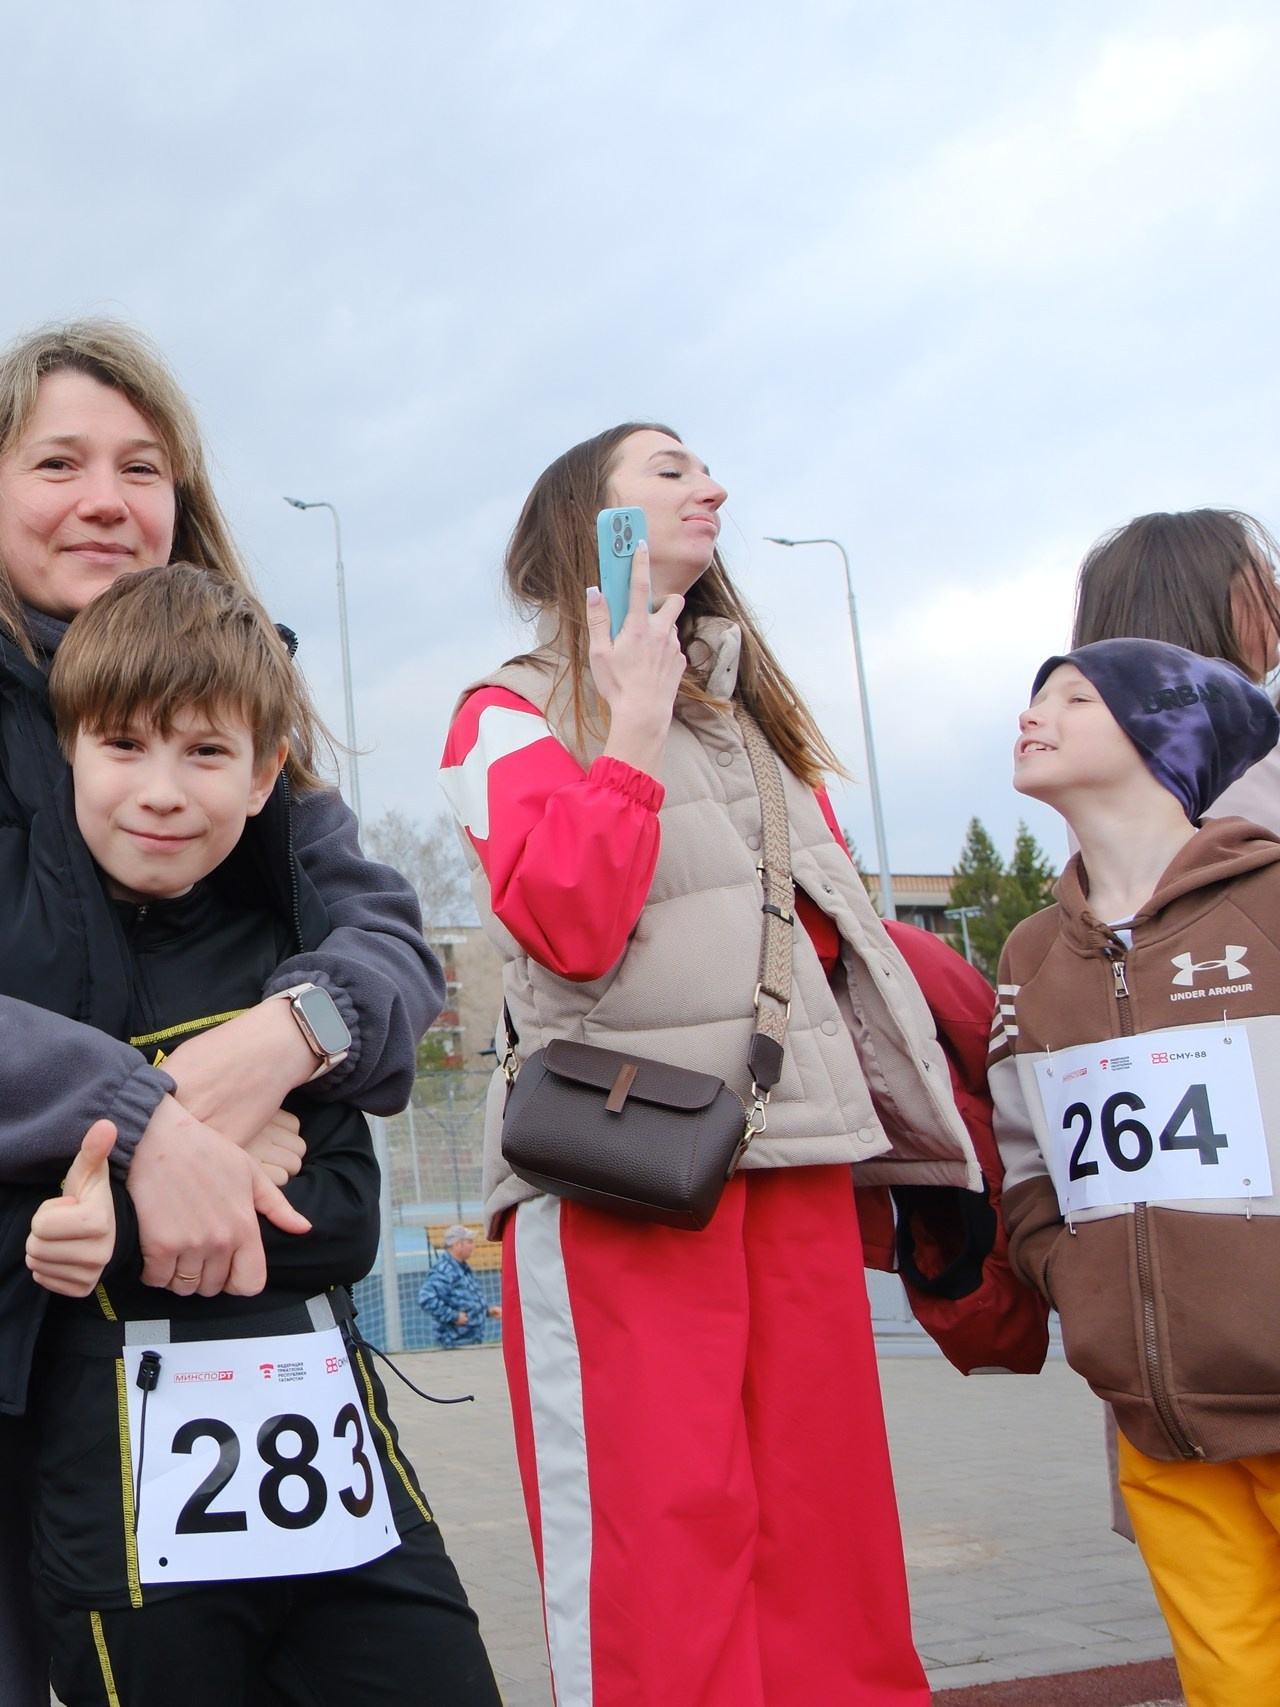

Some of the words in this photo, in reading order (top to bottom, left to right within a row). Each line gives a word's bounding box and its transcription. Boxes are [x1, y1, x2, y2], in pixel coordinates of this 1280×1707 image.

[1170, 989, 1206, 1002] UNDER
[1208, 983, 1253, 996] ARMOUR
[1169, 1050, 1207, 1061] СМУ-88
[1062, 1083, 1229, 1182] 264
[175, 1370, 233, 1381] МИНСПОРТ
[171, 1402, 374, 1535] 283
